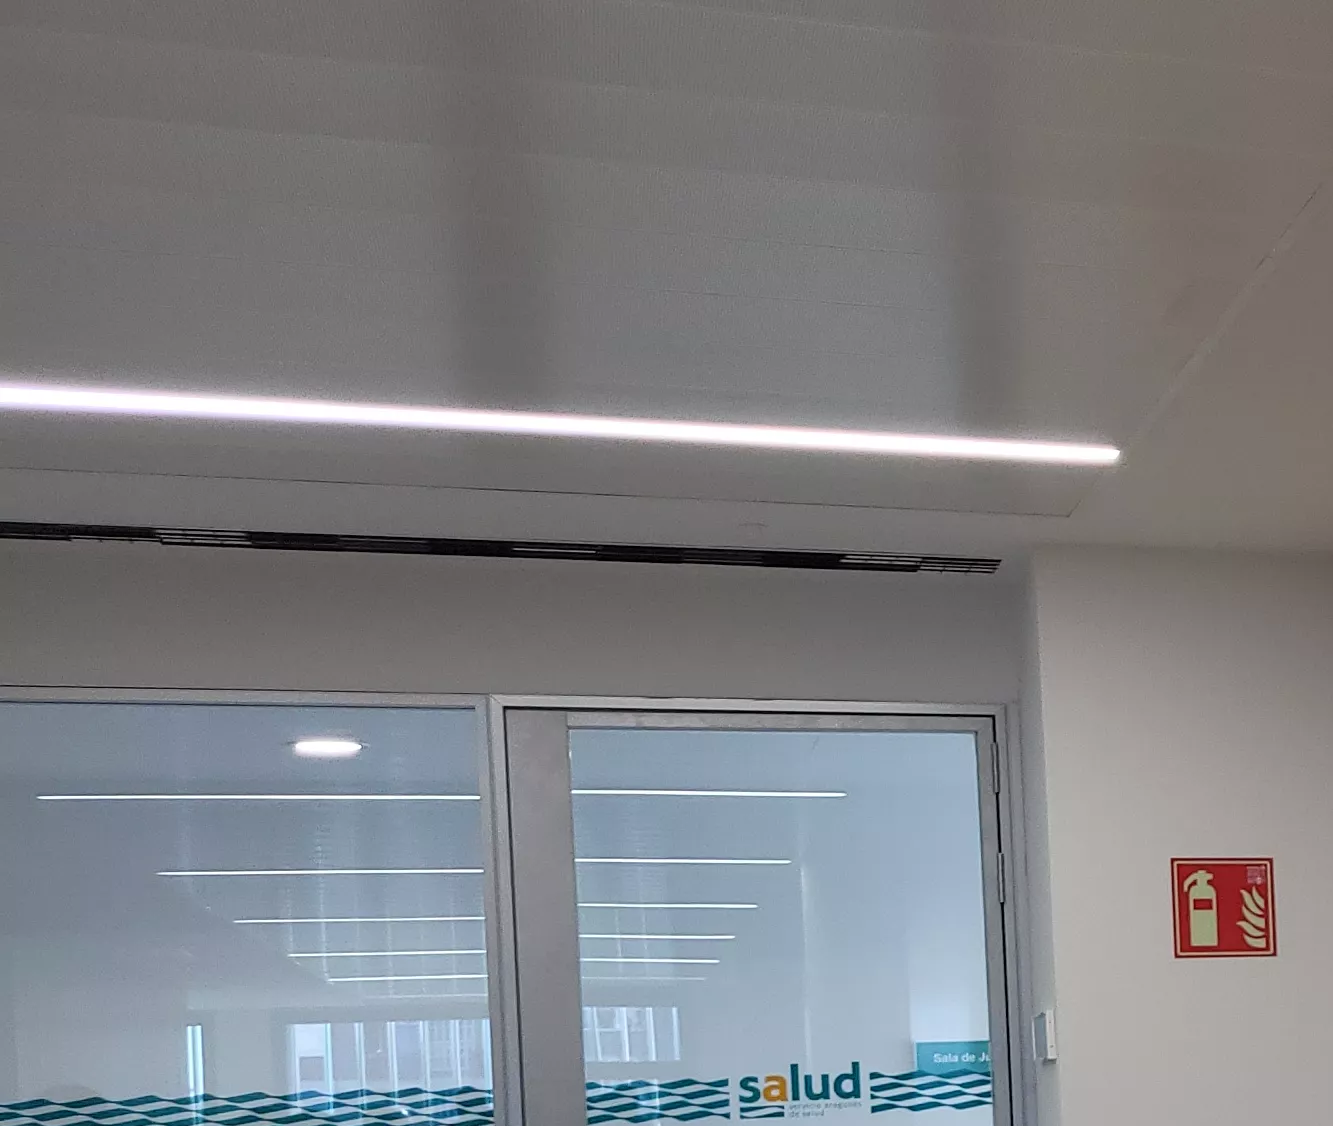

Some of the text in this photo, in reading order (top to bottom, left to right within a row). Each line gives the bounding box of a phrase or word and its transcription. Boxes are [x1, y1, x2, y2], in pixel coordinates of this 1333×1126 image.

[933, 1052, 959, 1063] Sala
[961, 1052, 976, 1063] de
[739, 1061, 861, 1104] salud
